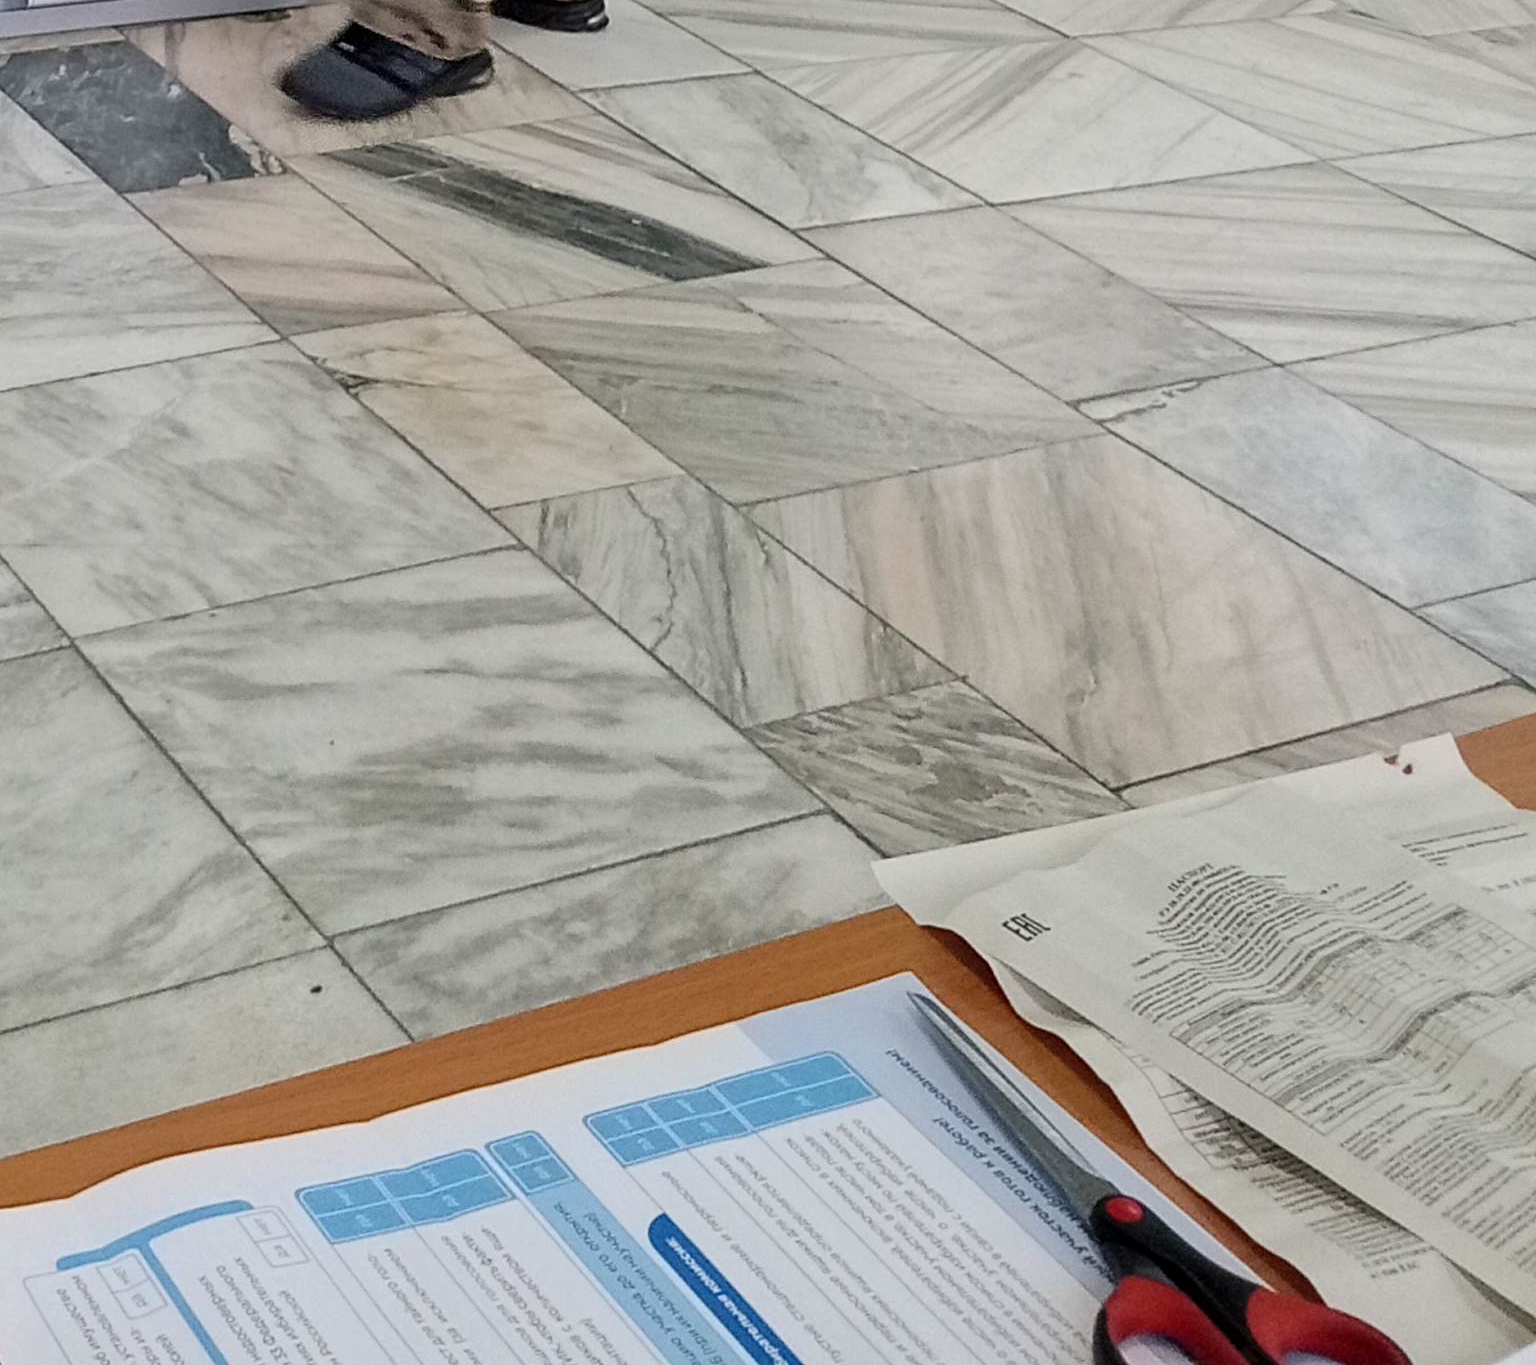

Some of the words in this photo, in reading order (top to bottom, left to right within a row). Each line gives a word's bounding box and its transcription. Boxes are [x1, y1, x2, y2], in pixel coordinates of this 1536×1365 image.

[884, 1047, 981, 1132] голосованием!
[932, 1115, 988, 1160] работе!
[974, 1130, 996, 1145] за
[660, 1168, 726, 1232] переносные
[989, 1169, 1033, 1203] готов
[990, 1143, 1082, 1223] наблюдении
[252, 1216, 273, 1235] нет
[272, 1243, 290, 1258] да
[1029, 1203, 1088, 1254] участок
[110, 1264, 133, 1284] нет
[382, 1245, 449, 1324] исключением
[485, 1265, 532, 1310] сверить
[497, 1252, 567, 1322] количеством
[596, 1253, 620, 1273] его
[664, 1235, 723, 1293] комиссия:
[727, 1242, 808, 1323] стационарные
[48, 1287, 107, 1350] имуществе
[63, 1274, 139, 1360] установленном
[130, 1292, 150, 1308] да
[191, 1274, 267, 1362] недостоверных
[210, 1264, 281, 1346] Федерального
[228, 1256, 301, 1341] избирательных
[276, 1288, 335, 1356] Российской
[384, 1280, 426, 1325] тайного
[629, 1291, 676, 1334] участка
[520, 1309, 559, 1344] чтобы
[268, 1346, 288, 1361] 33
